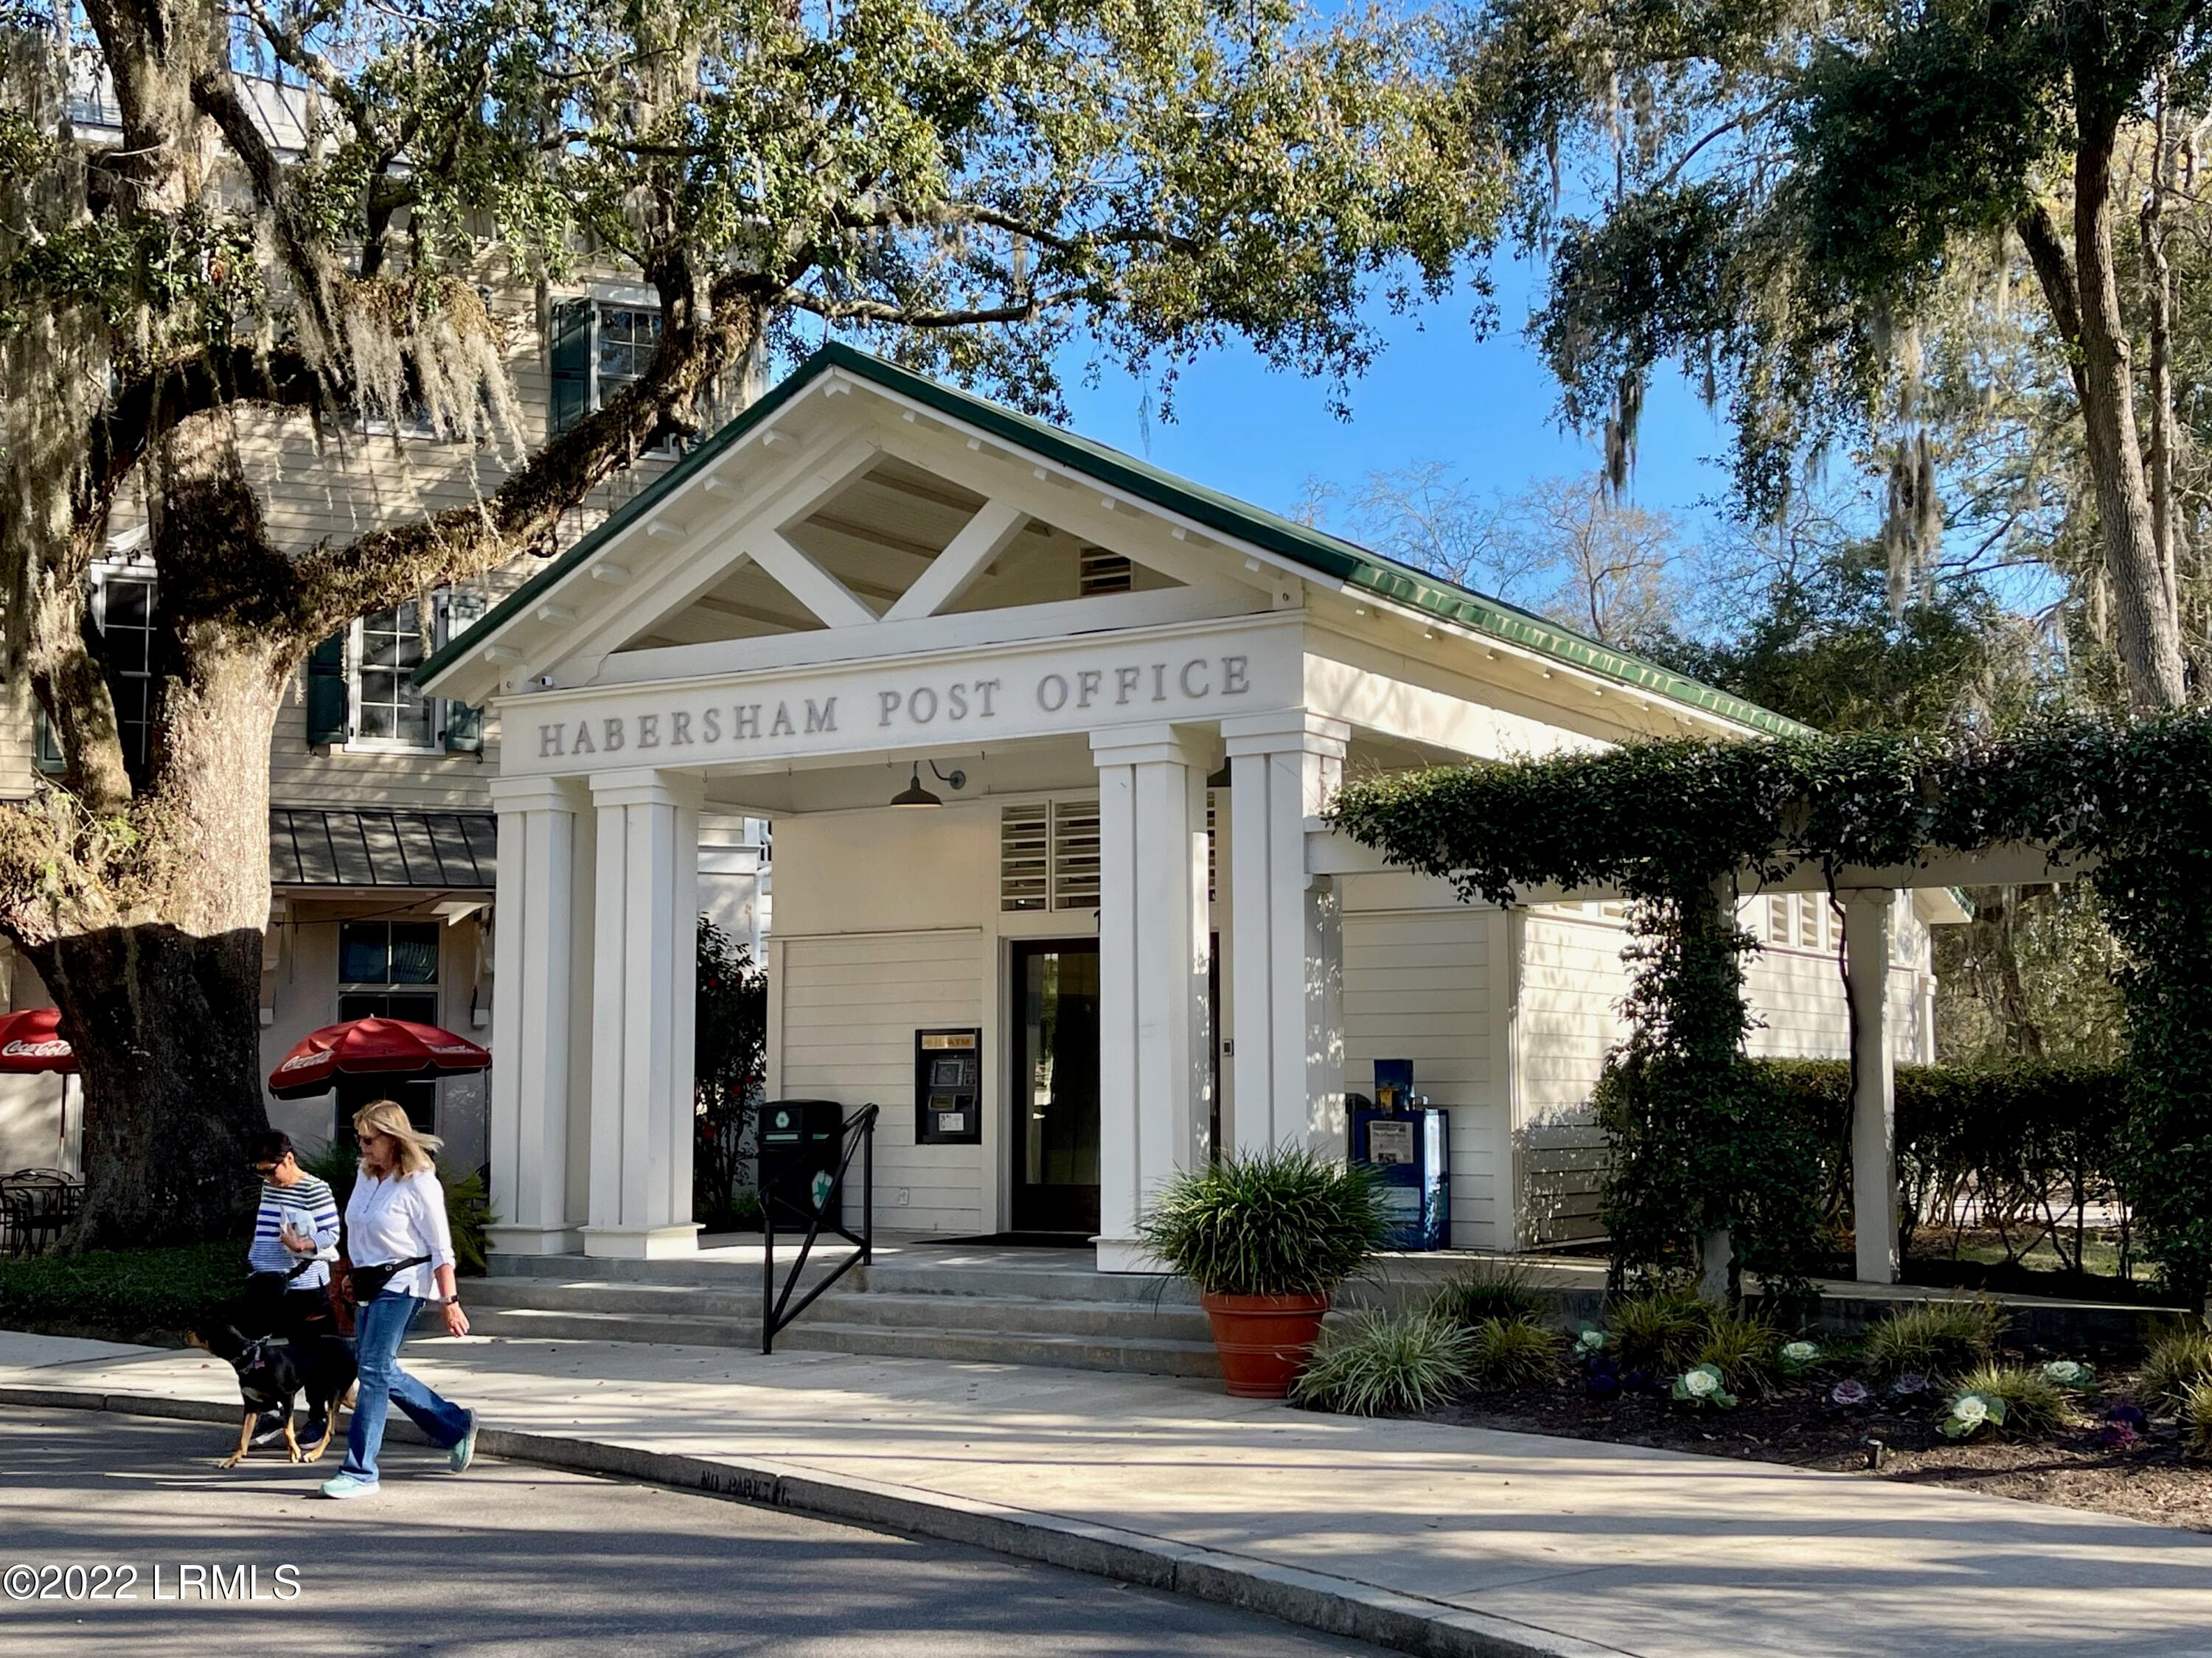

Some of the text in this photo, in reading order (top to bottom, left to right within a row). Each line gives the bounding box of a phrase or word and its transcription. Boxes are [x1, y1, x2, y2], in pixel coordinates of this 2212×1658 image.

[538, 655, 1250, 757] HABERSHAM POST OFFICE
[701, 1470, 720, 1492] NO
